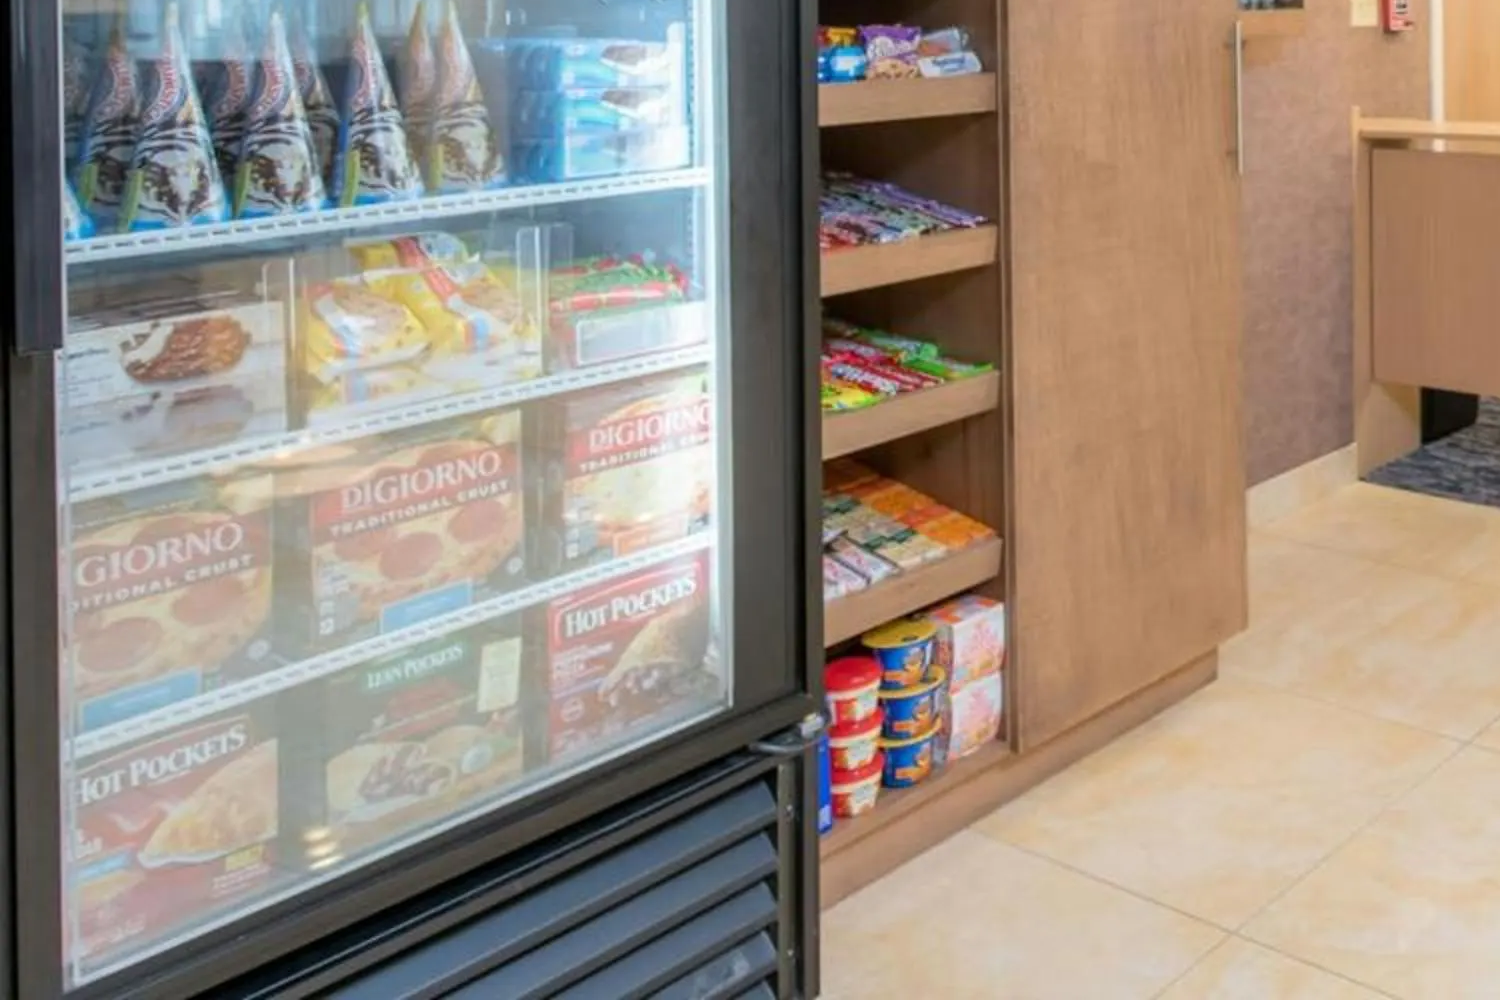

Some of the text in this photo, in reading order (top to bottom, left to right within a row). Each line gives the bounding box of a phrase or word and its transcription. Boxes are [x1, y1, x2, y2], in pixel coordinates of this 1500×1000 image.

[330, 479, 510, 538] TRADITIONAL CRUST
[340, 450, 502, 513] DIGIORNO
[75, 522, 244, 588] GIORNO
[184, 553, 255, 583] CRUST
[565, 577, 697, 638] HOT POCKETS
[130, 723, 248, 788] POCKETS
